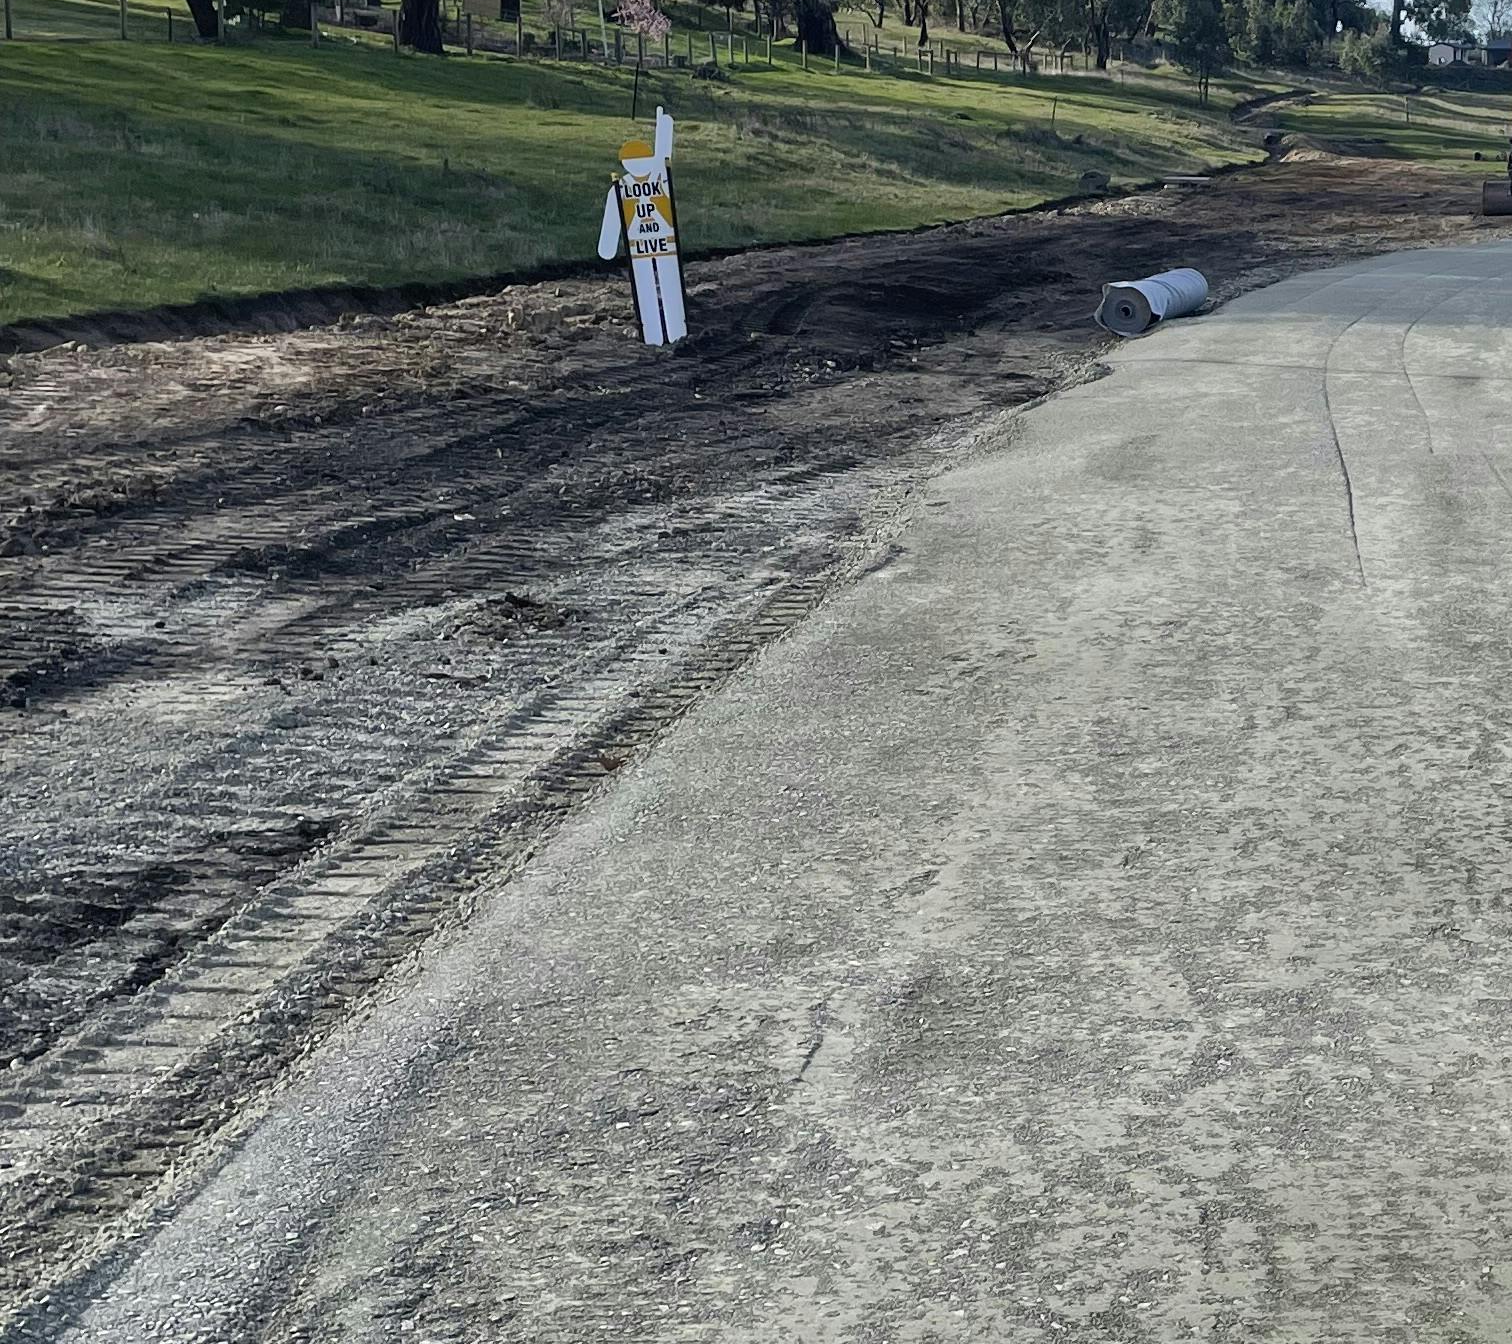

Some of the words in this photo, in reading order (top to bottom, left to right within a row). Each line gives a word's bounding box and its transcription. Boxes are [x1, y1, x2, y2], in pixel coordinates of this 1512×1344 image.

[624, 181, 661, 198] LOOK
[636, 203, 656, 218] UP
[639, 222, 660, 234] AND
[636, 238, 668, 254] LIVE
